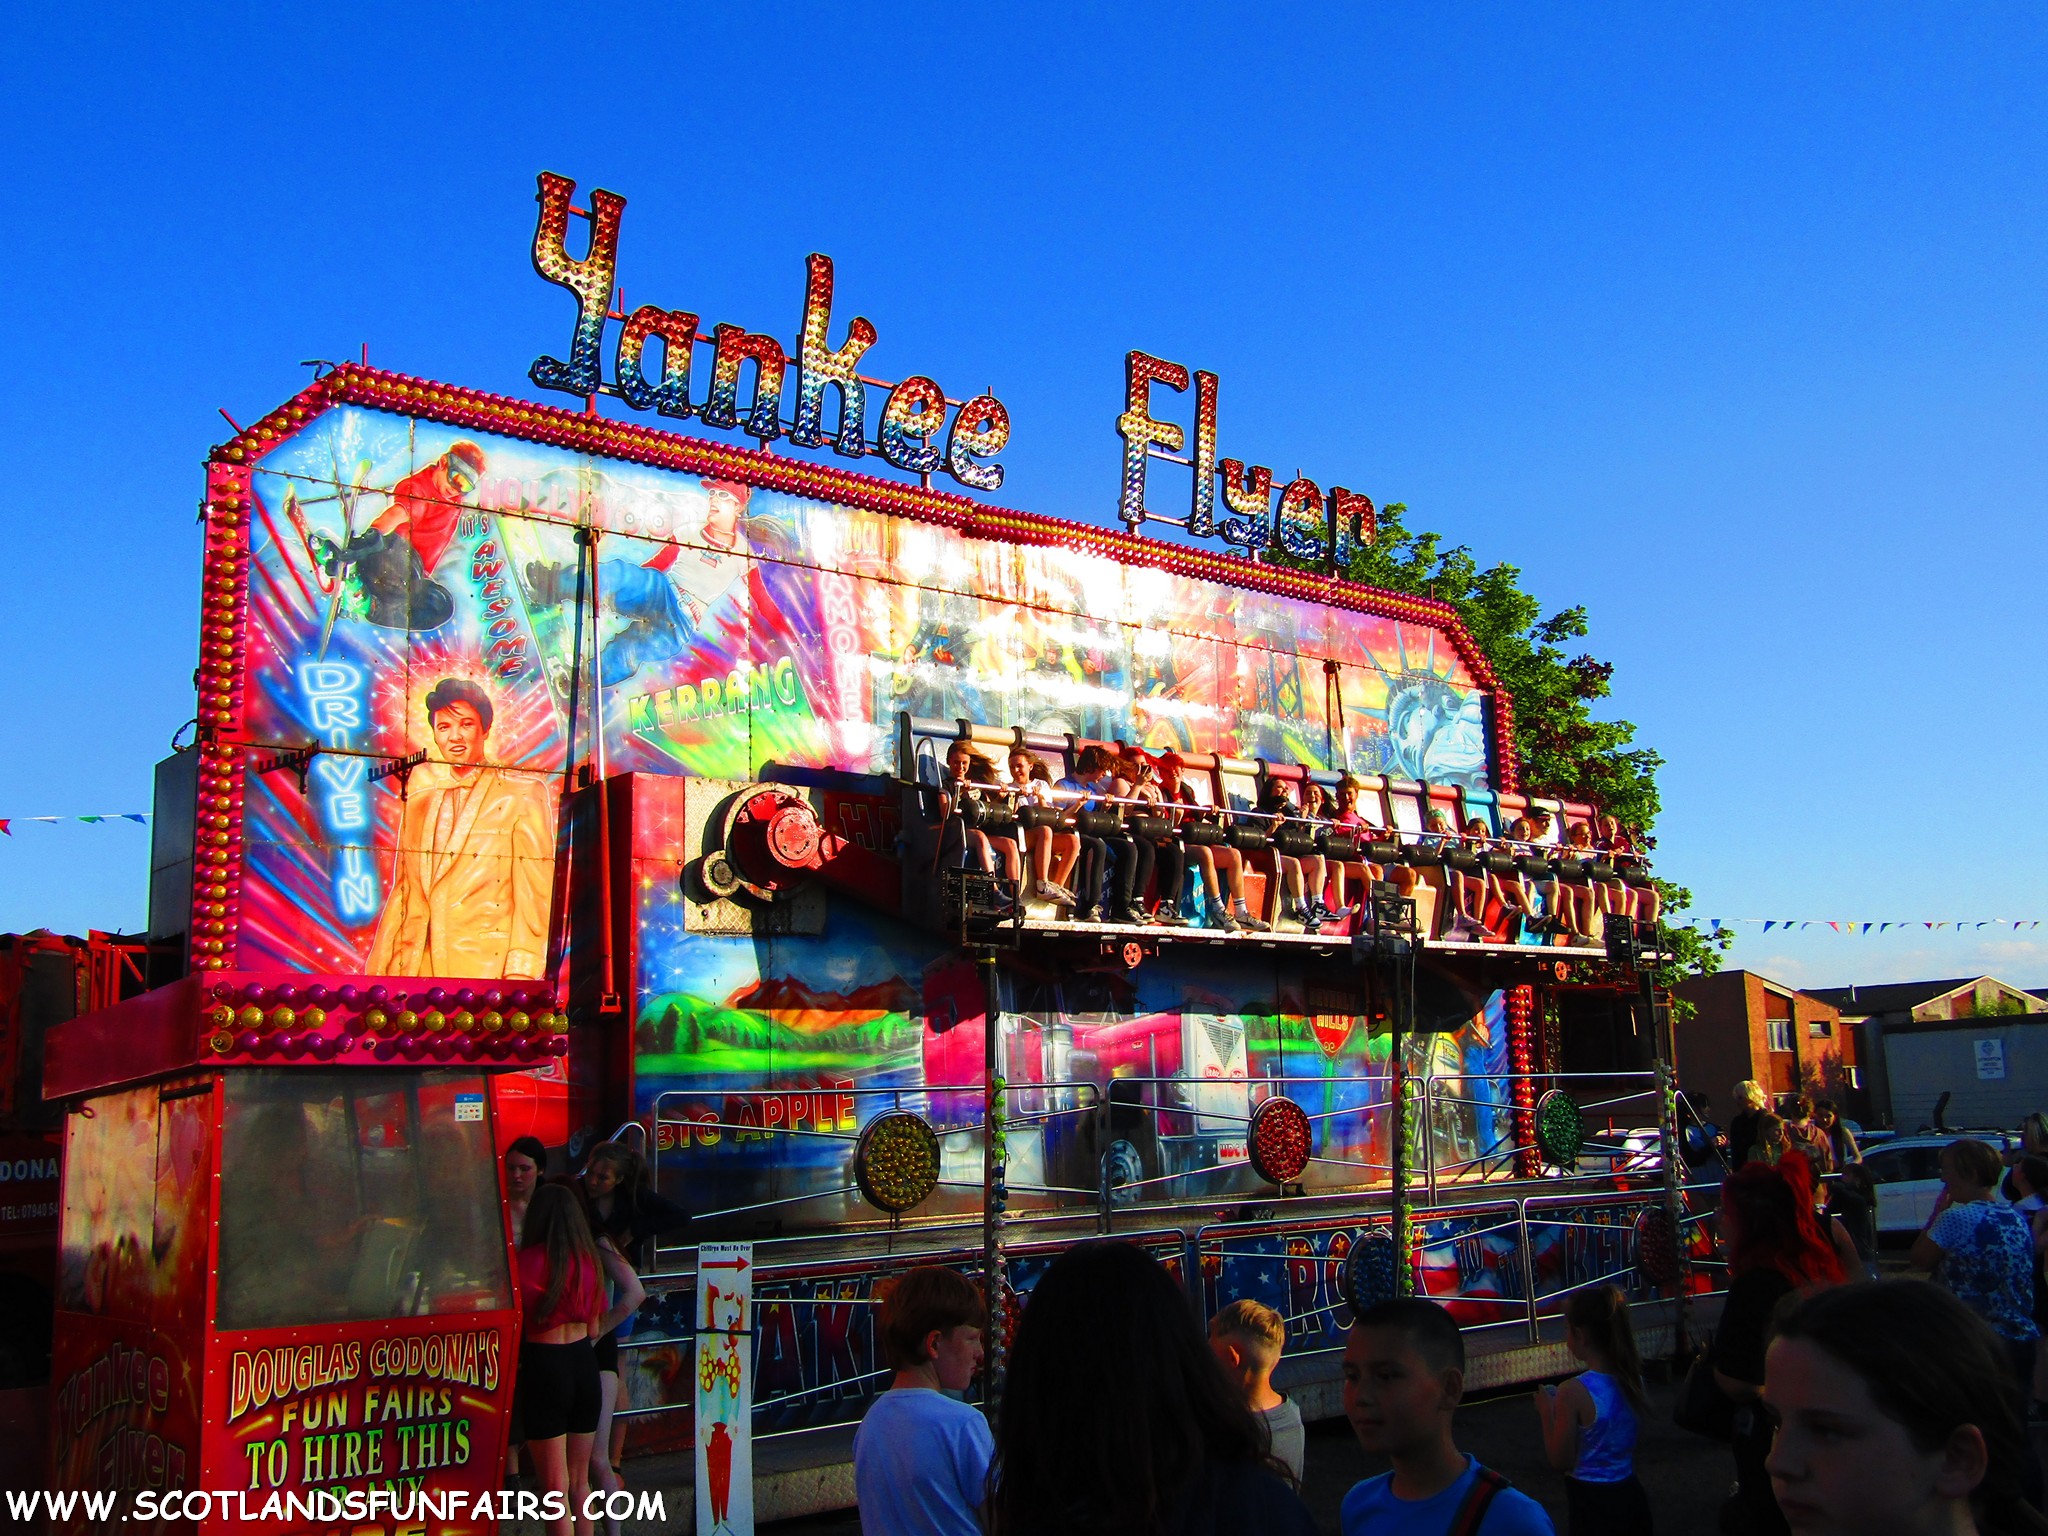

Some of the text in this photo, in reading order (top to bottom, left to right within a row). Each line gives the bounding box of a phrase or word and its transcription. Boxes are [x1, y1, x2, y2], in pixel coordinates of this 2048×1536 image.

[530, 170, 1378, 568] Yankee Flyer
[461, 514, 490, 538] IT'S
[471, 541, 528, 680] AWESOME
[629, 655, 797, 734] KERRANG
[301, 663, 375, 915] DRIVE IN
[650, 1078, 857, 1151] BIG APPLE
[57, 1341, 170, 1462] Yankee
[230, 1330, 499, 1419] DOUGLAS CODONA'S
[281, 1384, 452, 1433] FUN FAIRS
[246, 1419, 470, 1489] TO HIRE THIS
